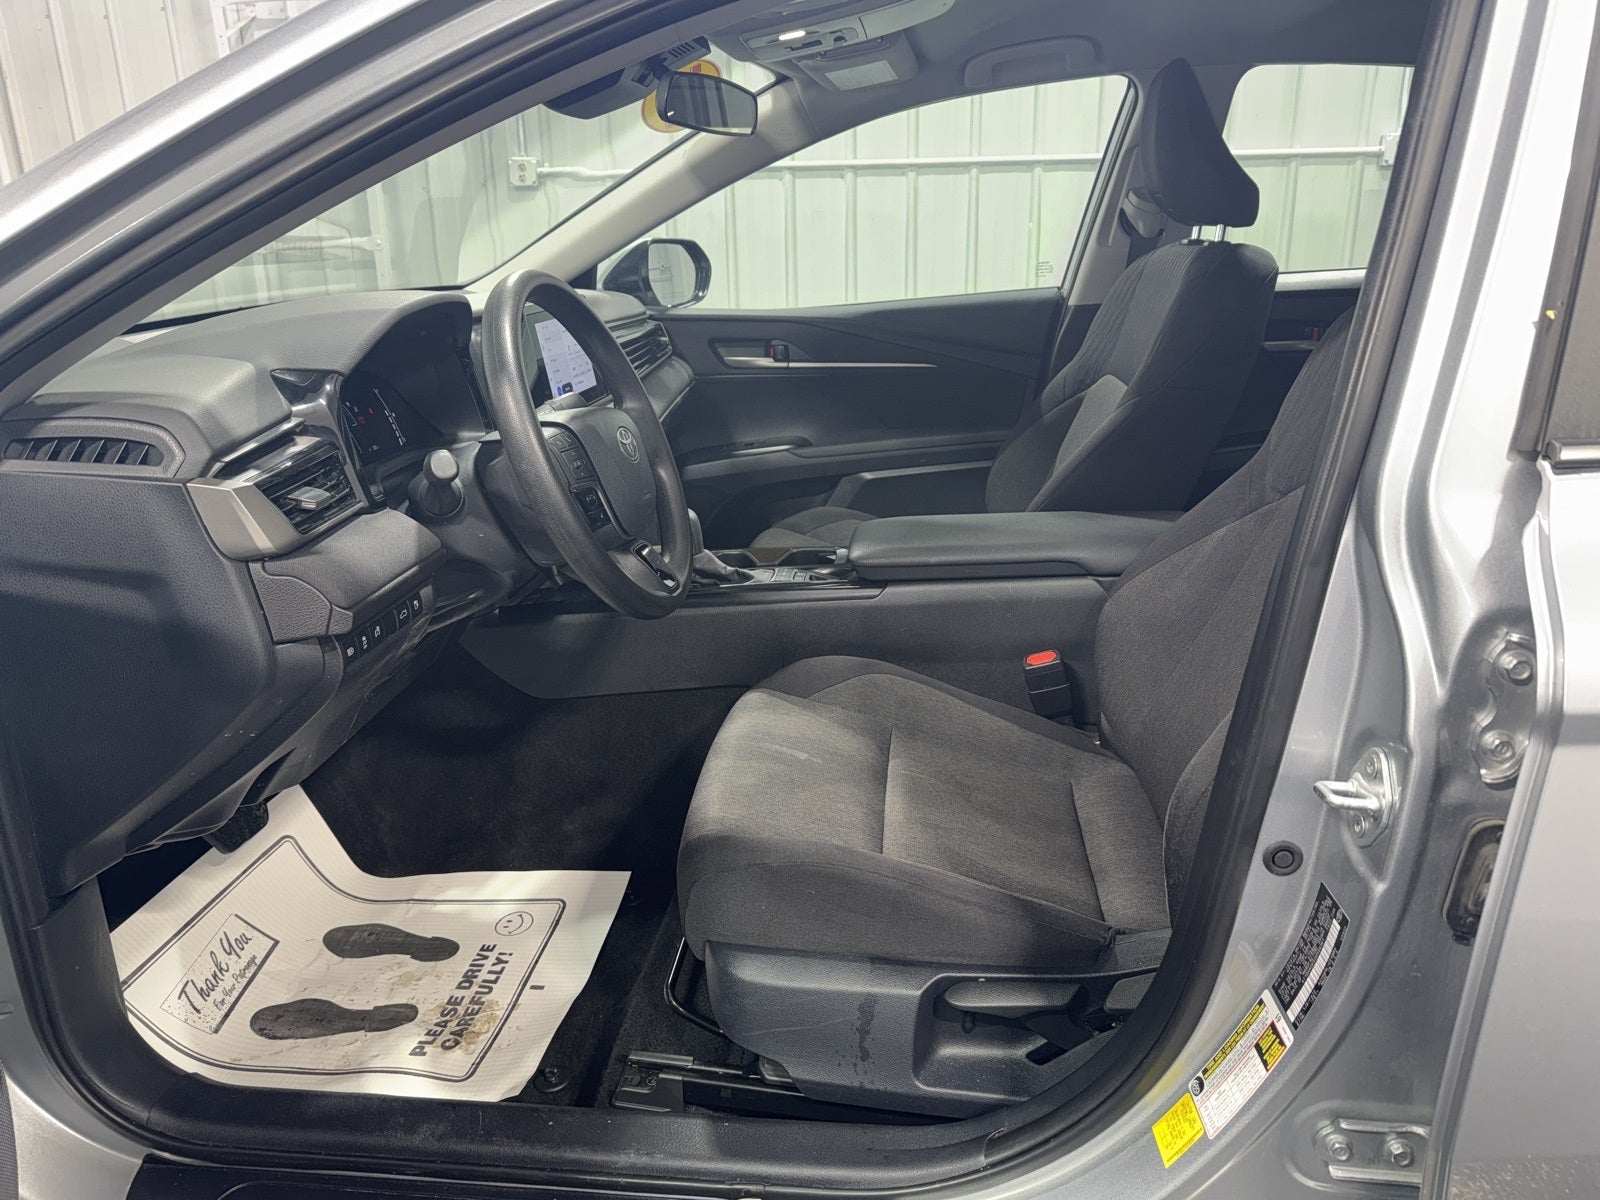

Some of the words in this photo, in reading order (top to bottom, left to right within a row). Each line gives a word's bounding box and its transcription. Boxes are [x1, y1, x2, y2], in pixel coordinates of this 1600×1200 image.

[177, 950, 230, 1014] Thank
[219, 931, 253, 959] You
[213, 998, 227, 1011] For
[222, 983, 236, 998] Your
[408, 995, 466, 1057] PLEASE
[454, 943, 497, 991] DRIVE
[440, 951, 514, 1050] CAREFULLY!
